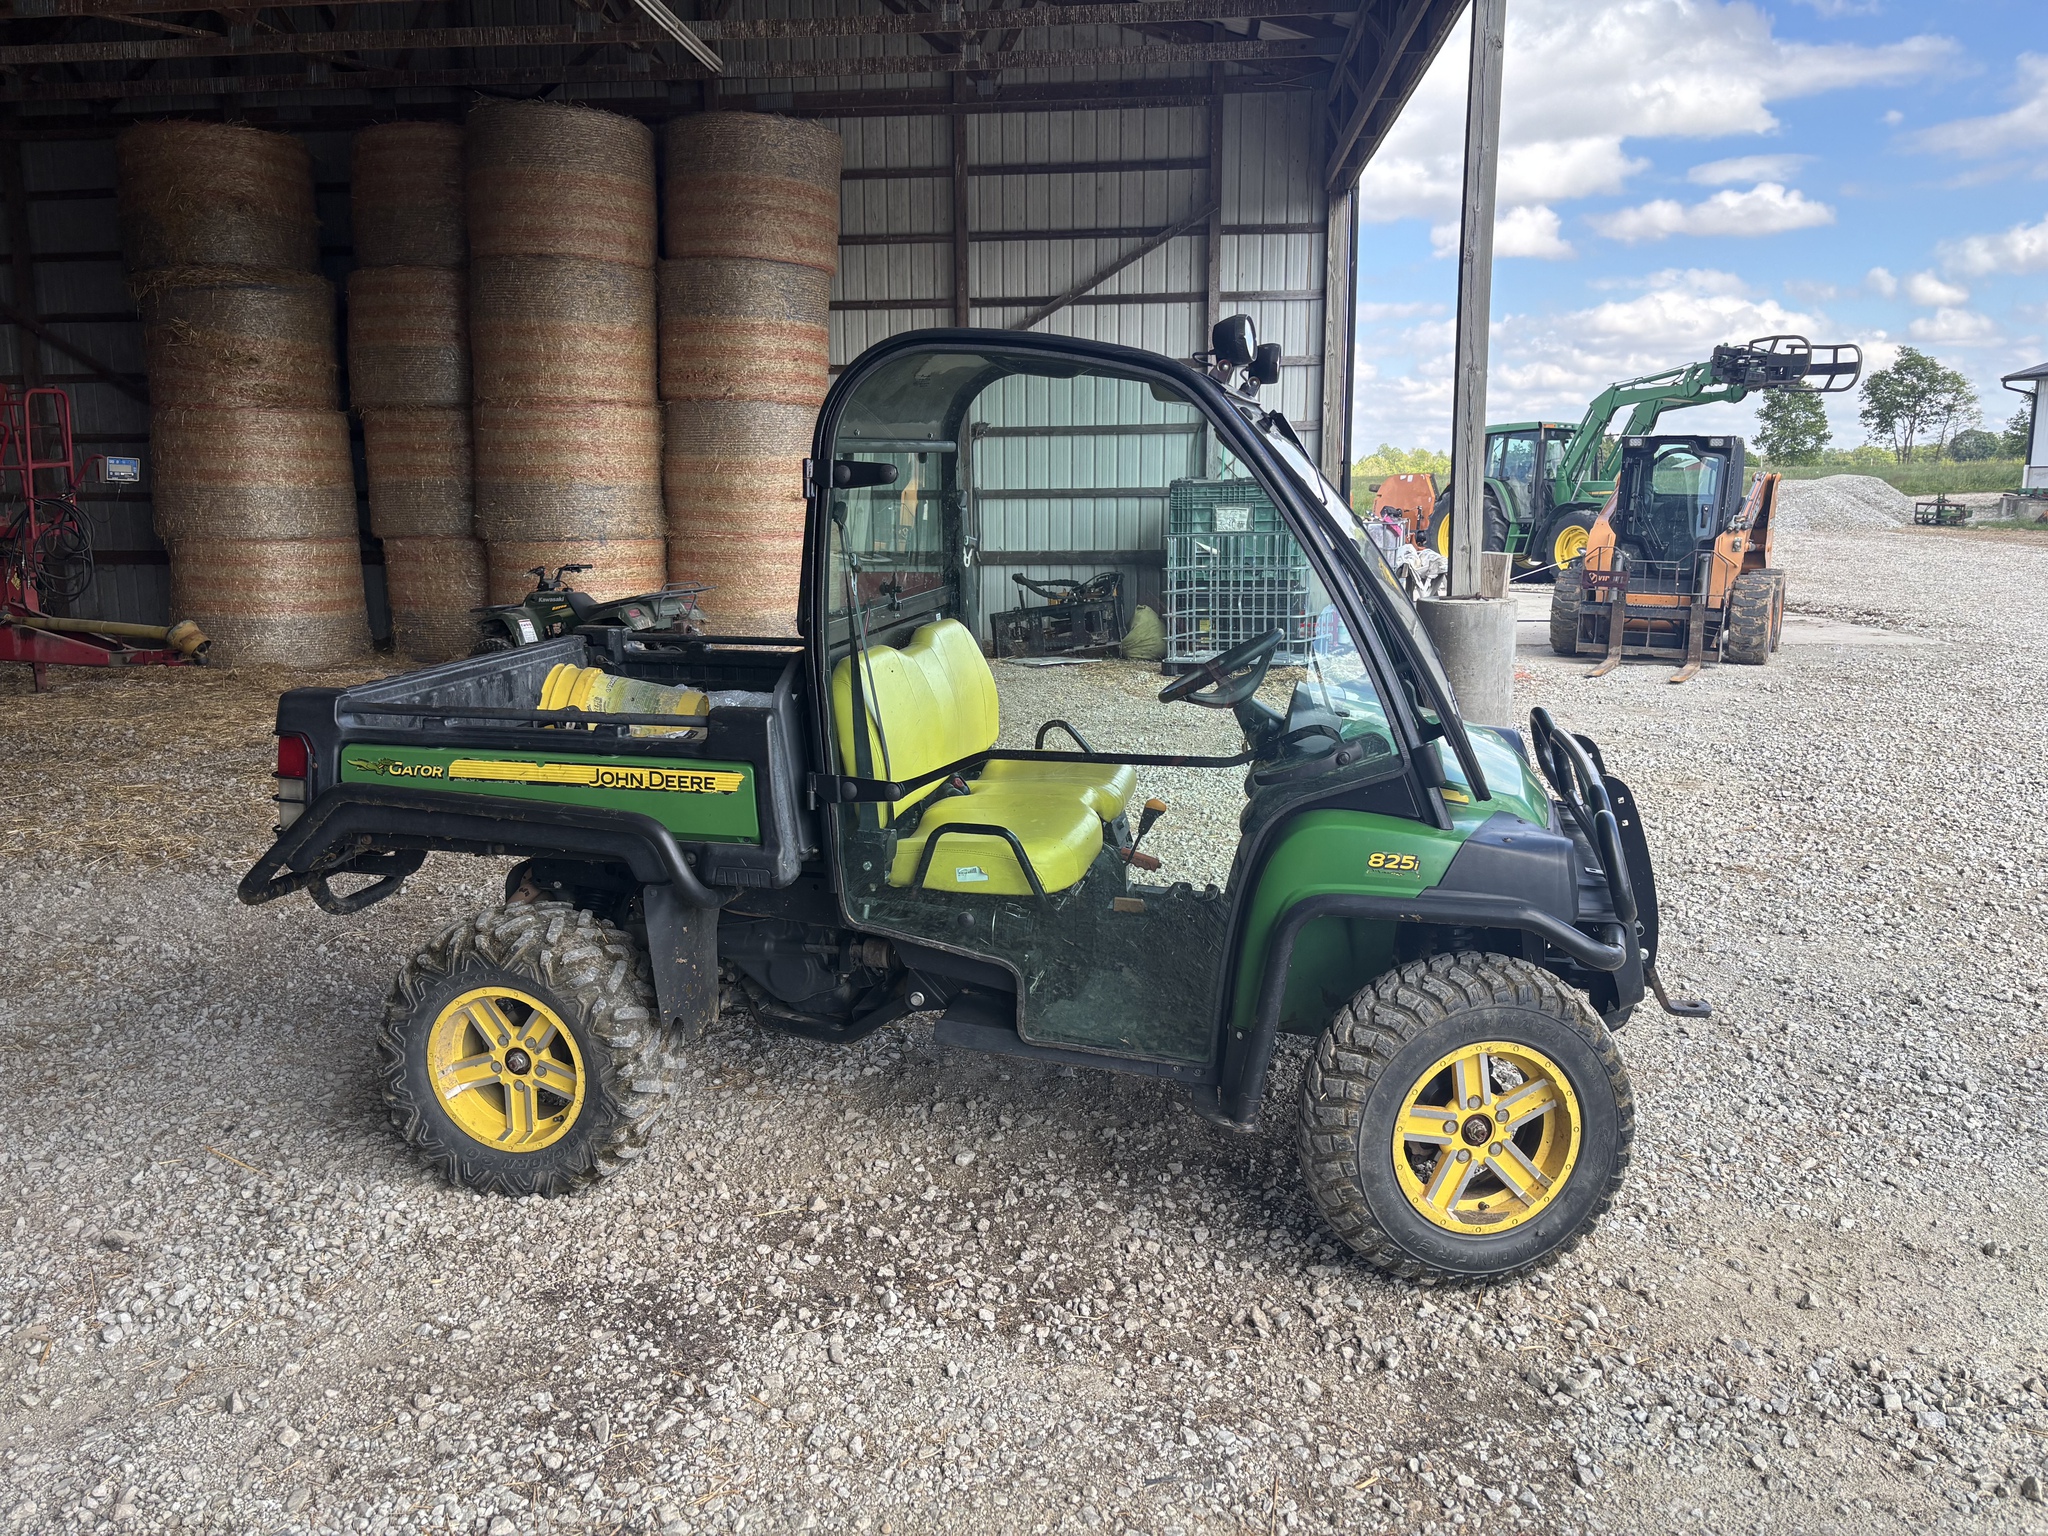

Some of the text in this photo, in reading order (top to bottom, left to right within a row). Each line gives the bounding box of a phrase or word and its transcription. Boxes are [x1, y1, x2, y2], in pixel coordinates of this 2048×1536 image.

[389, 761, 443, 778] GATOR
[588, 768, 716, 791] JOHN DEERE
[1367, 852, 1420, 871] 825i
